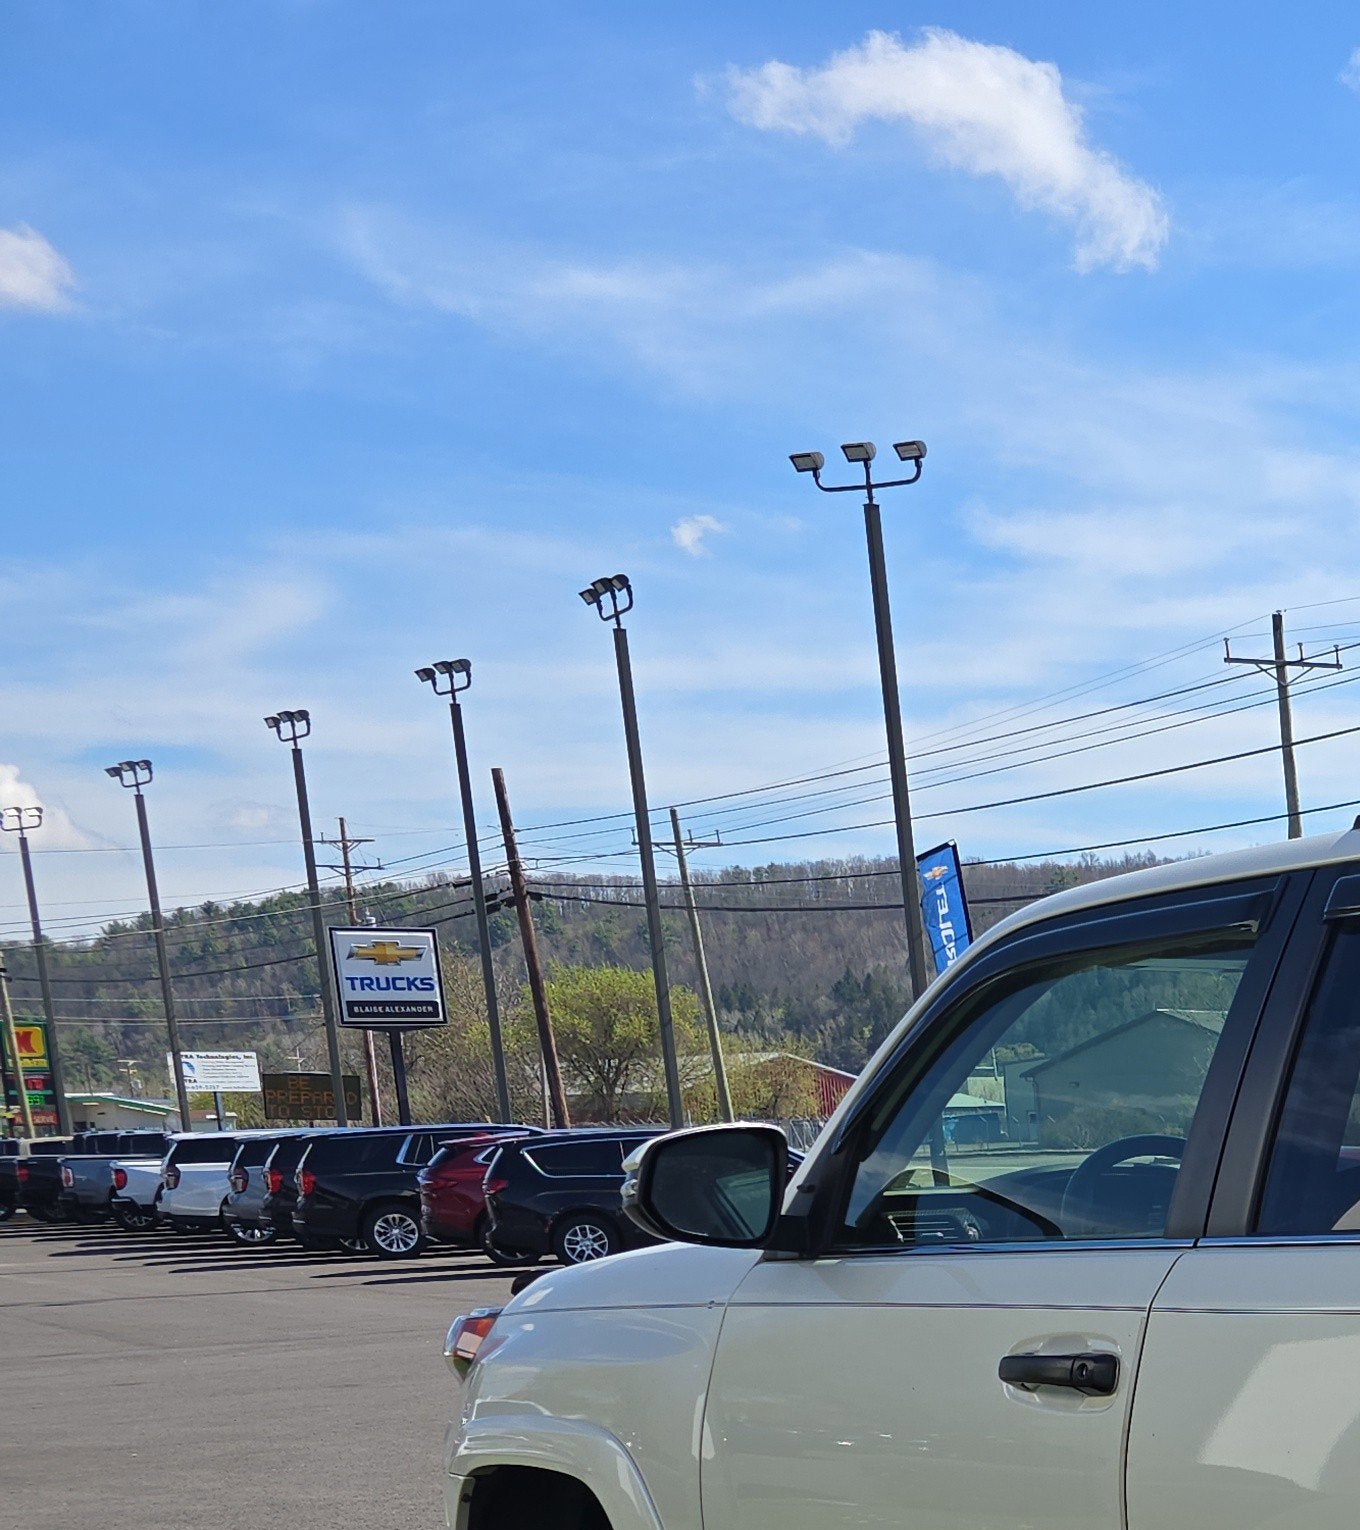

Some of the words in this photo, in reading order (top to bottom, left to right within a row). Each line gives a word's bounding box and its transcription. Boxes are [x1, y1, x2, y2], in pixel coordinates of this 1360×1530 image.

[345, 976, 435, 992] TRUCKS
[288, 1076, 309, 1090] BE
[264, 1090, 358, 1105] PREPARD
[268, 1104, 290, 1119] TO
[301, 1105, 336, 1119] STO
